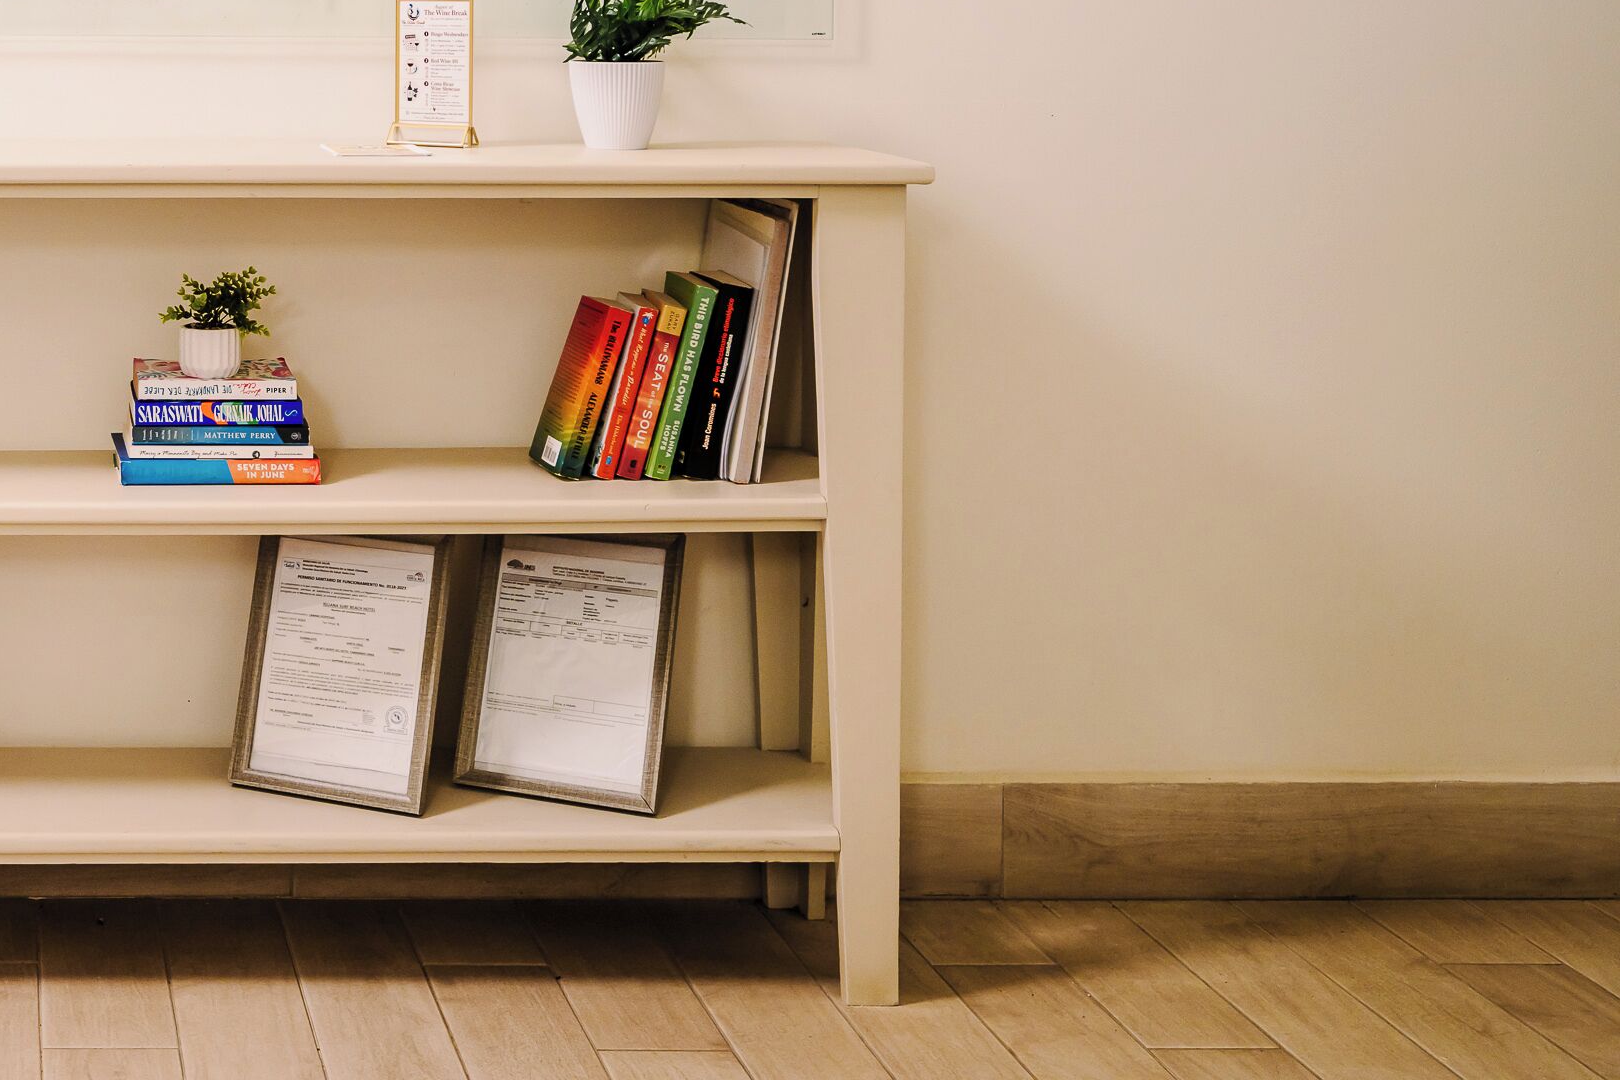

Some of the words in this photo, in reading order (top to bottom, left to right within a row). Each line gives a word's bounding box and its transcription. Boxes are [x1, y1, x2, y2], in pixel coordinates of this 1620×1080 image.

[695, 297, 710, 322] THIS
[689, 323, 703, 348] BIRD
[652, 353, 669, 391] SEAT
[683, 350, 696, 372] HAS
[144, 386, 165, 395] LIEBE
[167, 386, 182, 395] DER
[673, 374, 691, 413] FLOWN
[137, 405, 204, 423] SARASWATI
[213, 404, 254, 422] GURNAIK
[255, 404, 285, 422] JOHAL
[634, 410, 653, 449] SOUL
[237, 463, 269, 471] SEVEN
[270, 463, 295, 471] DAYS
[246, 471, 259, 479] IN
[260, 471, 285, 479] JUNE
